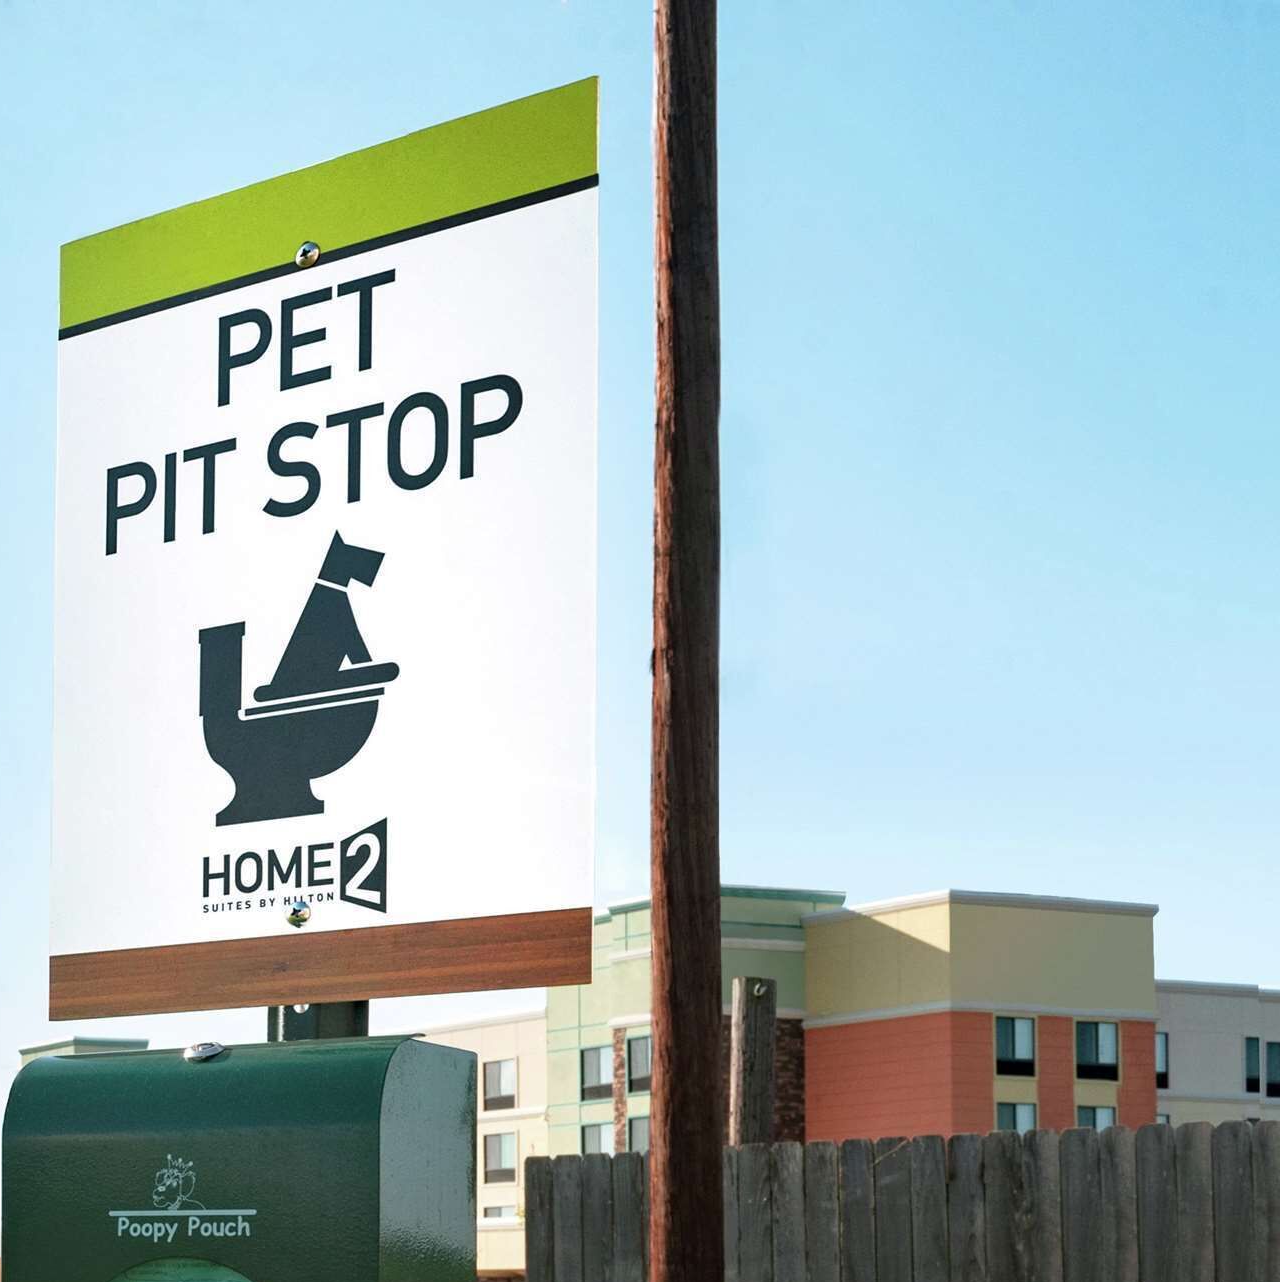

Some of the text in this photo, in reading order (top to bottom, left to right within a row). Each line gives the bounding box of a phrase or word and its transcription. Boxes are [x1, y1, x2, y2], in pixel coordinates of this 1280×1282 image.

[217, 268, 396, 407] PET
[105, 374, 524, 556] PIT STOP
[202, 842, 334, 898] HOME
[203, 900, 251, 913] SUITES
[260, 898, 276, 908] BY
[117, 1215, 250, 1243] Poopy Pouch
